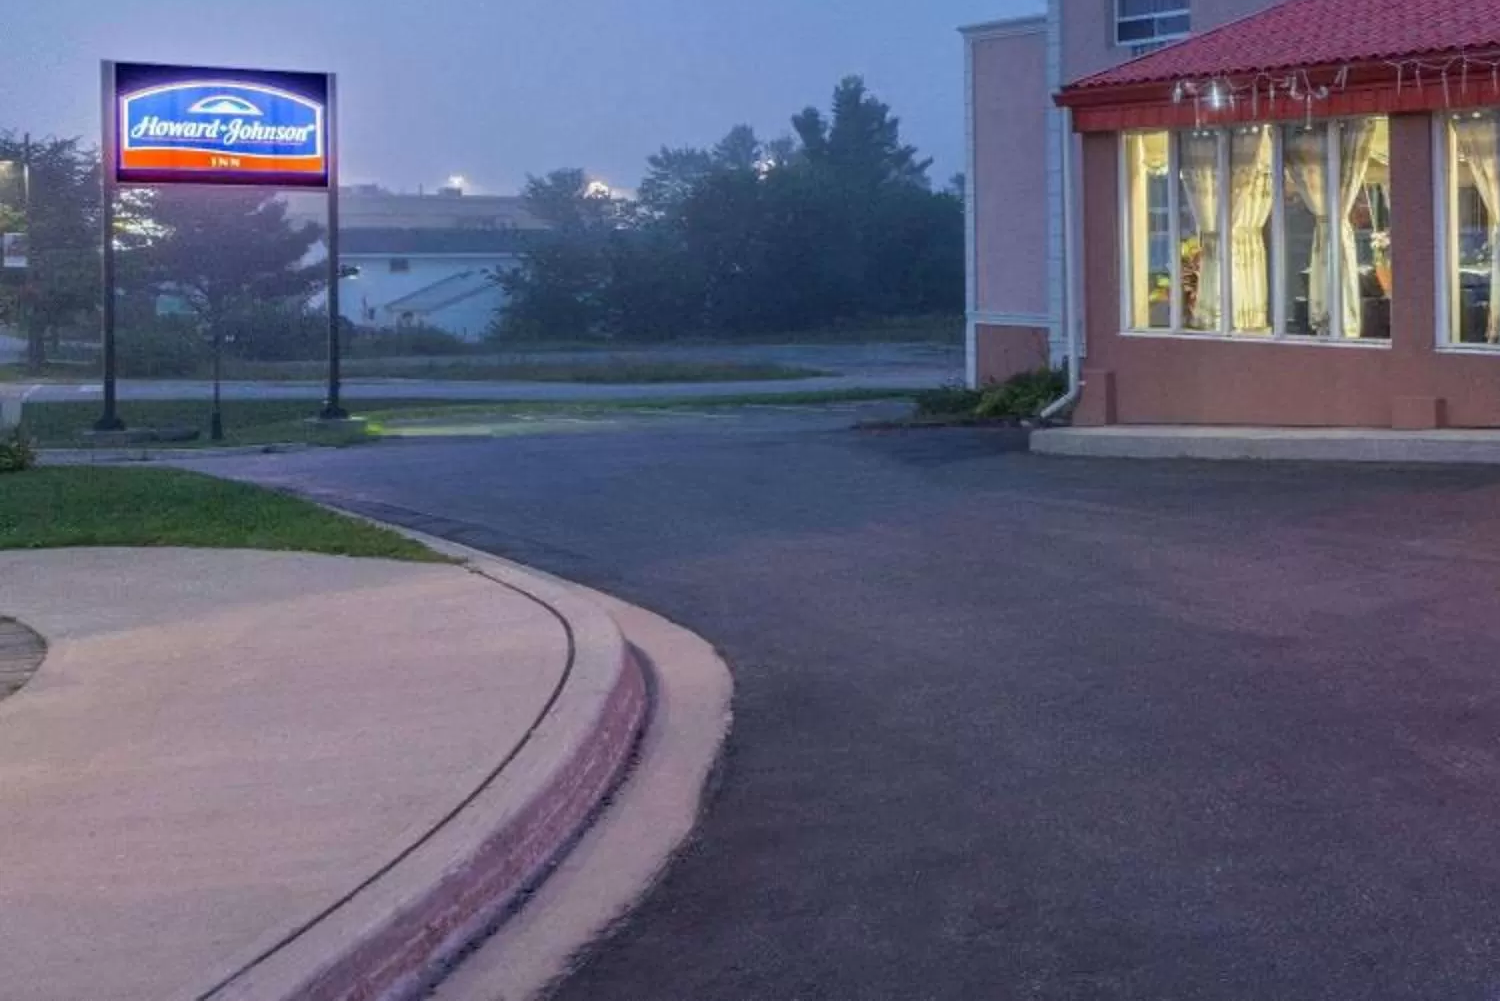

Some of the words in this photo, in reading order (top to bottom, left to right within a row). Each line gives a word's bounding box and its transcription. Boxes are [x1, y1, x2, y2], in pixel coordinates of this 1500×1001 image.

[131, 115, 220, 139] Howard
[223, 118, 315, 145] Johnson
[210, 157, 240, 168] INN
